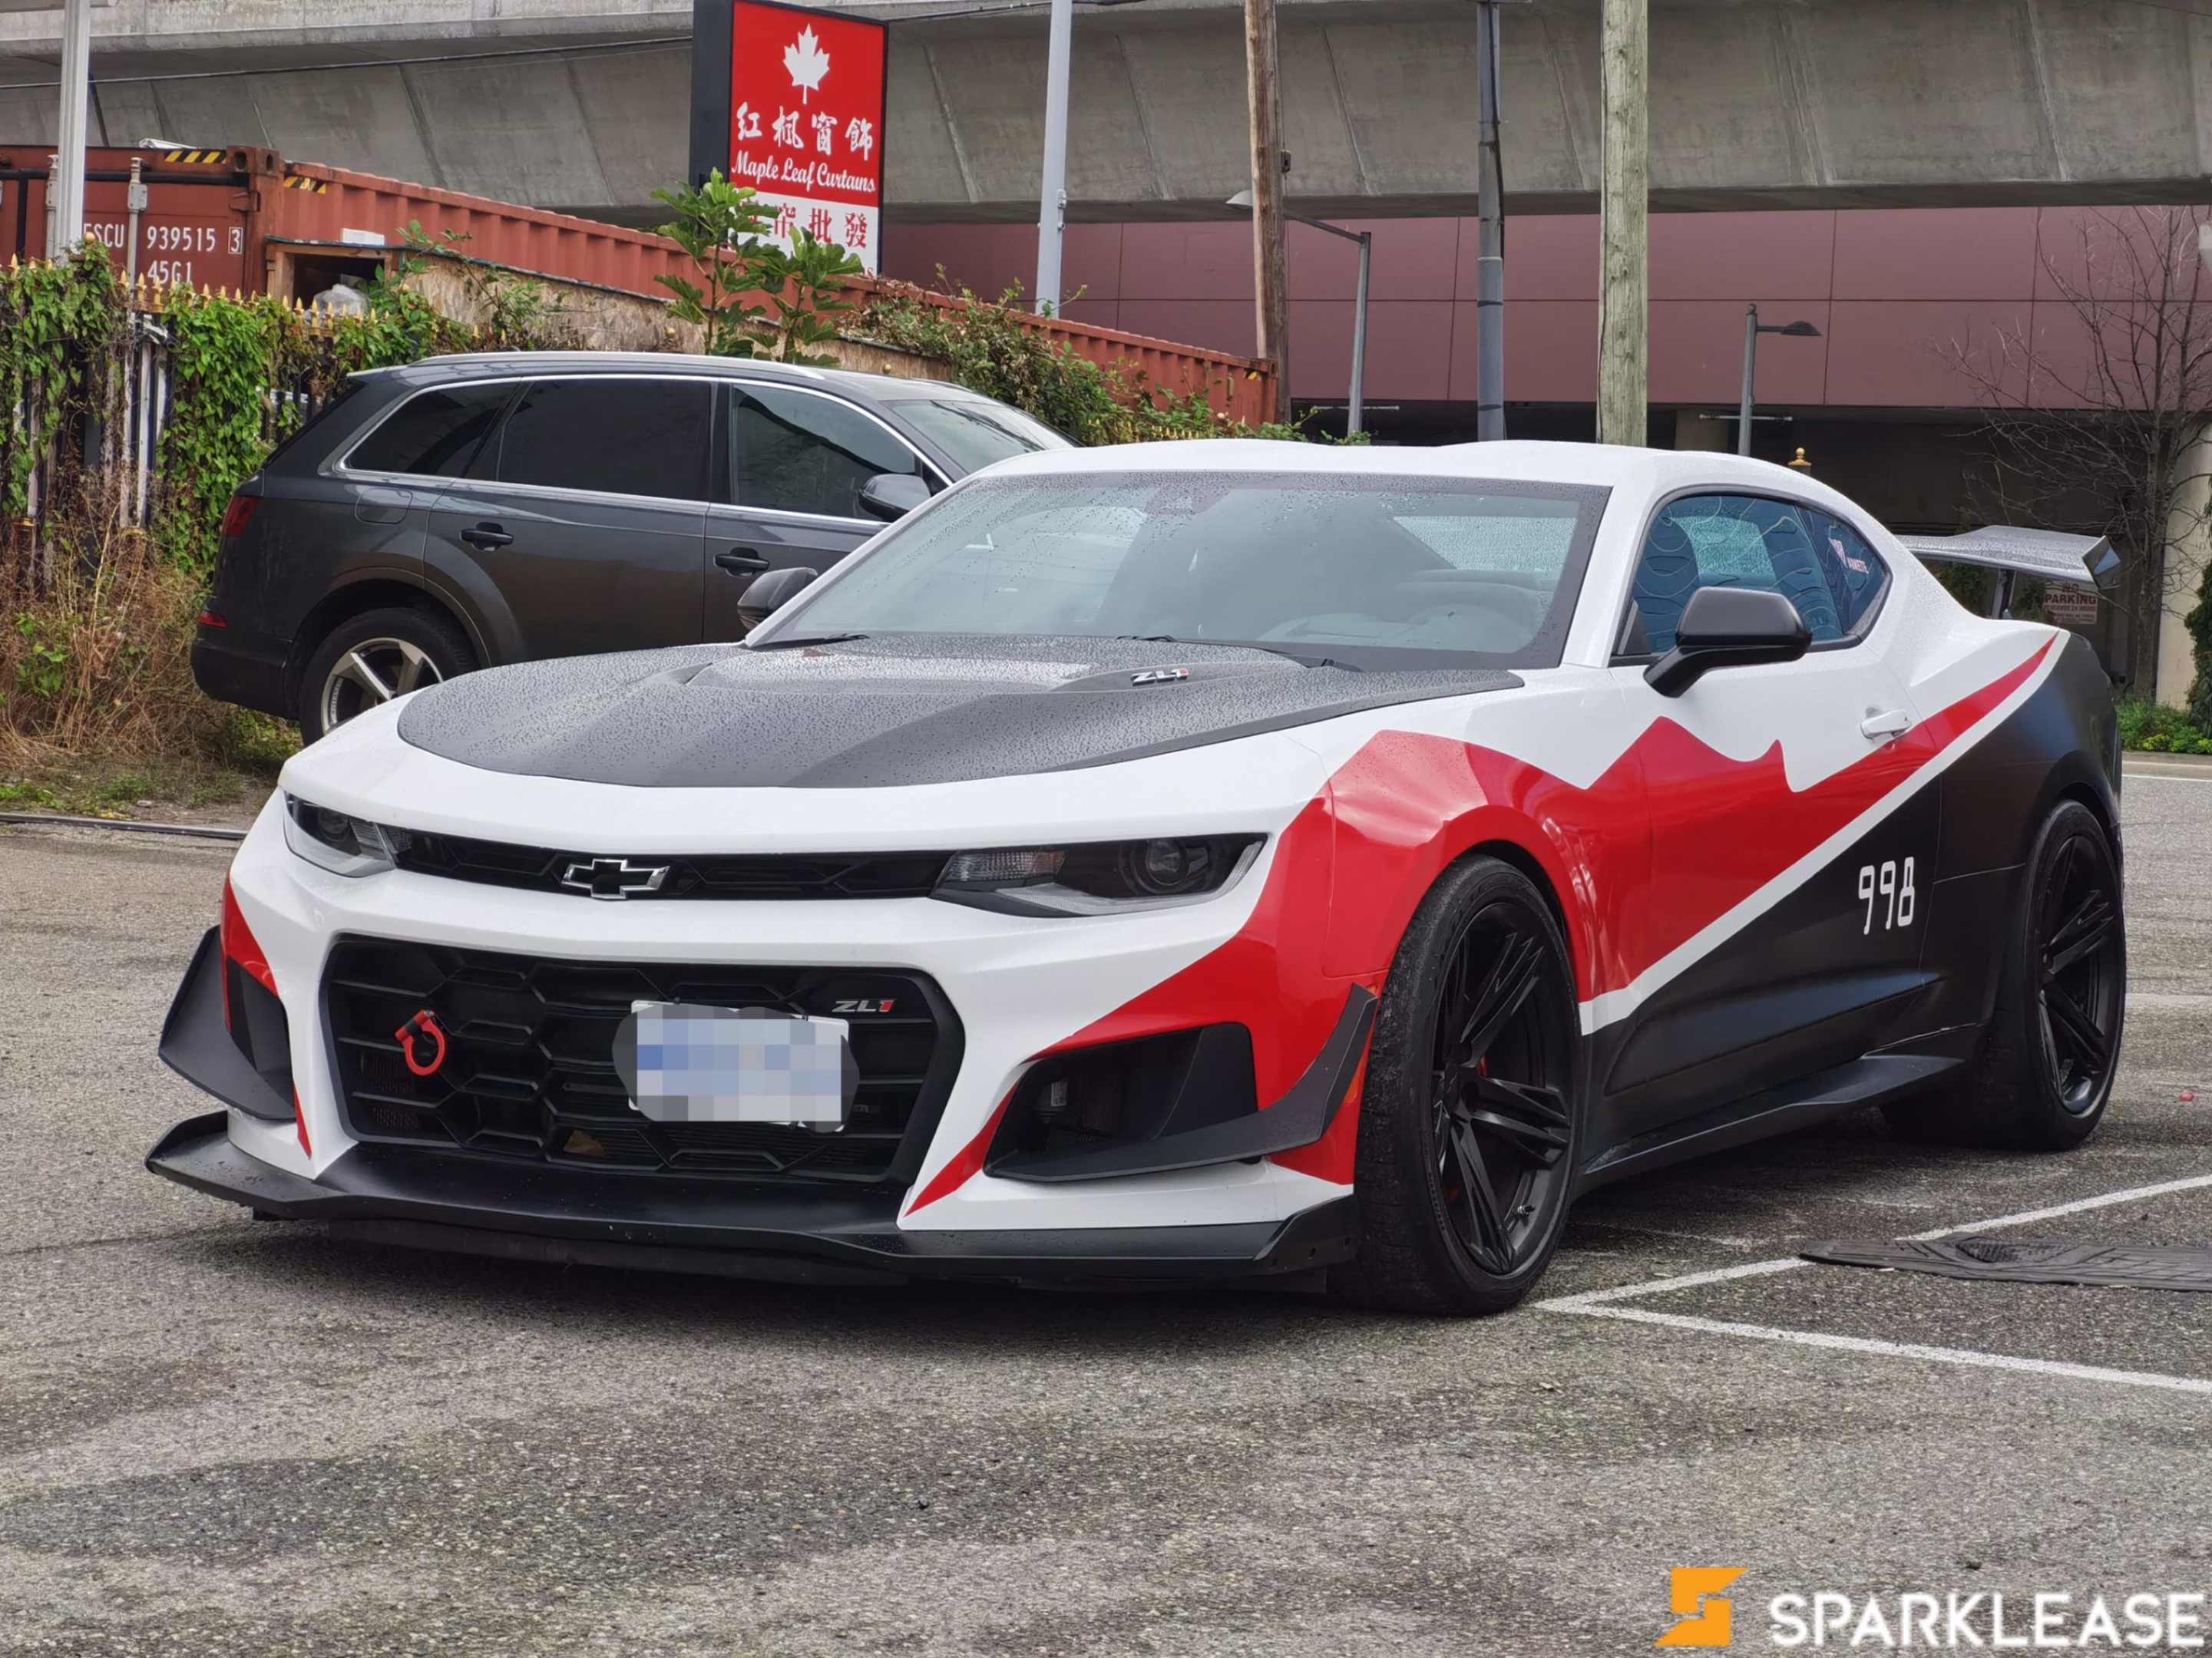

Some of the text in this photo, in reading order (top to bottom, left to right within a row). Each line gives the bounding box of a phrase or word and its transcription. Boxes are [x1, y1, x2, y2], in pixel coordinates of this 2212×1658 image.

[732, 150, 876, 193] Maple Leaf Curtains
[147, 226, 216, 253] 939515
[230, 228, 241, 253] 3
[147, 260, 192, 285] 45G1
[2045, 593, 2096, 605] PARKING
[1130, 668, 1190, 685] ZL1
[1858, 856, 1916, 936] 998
[832, 999, 894, 1012] ZL1
